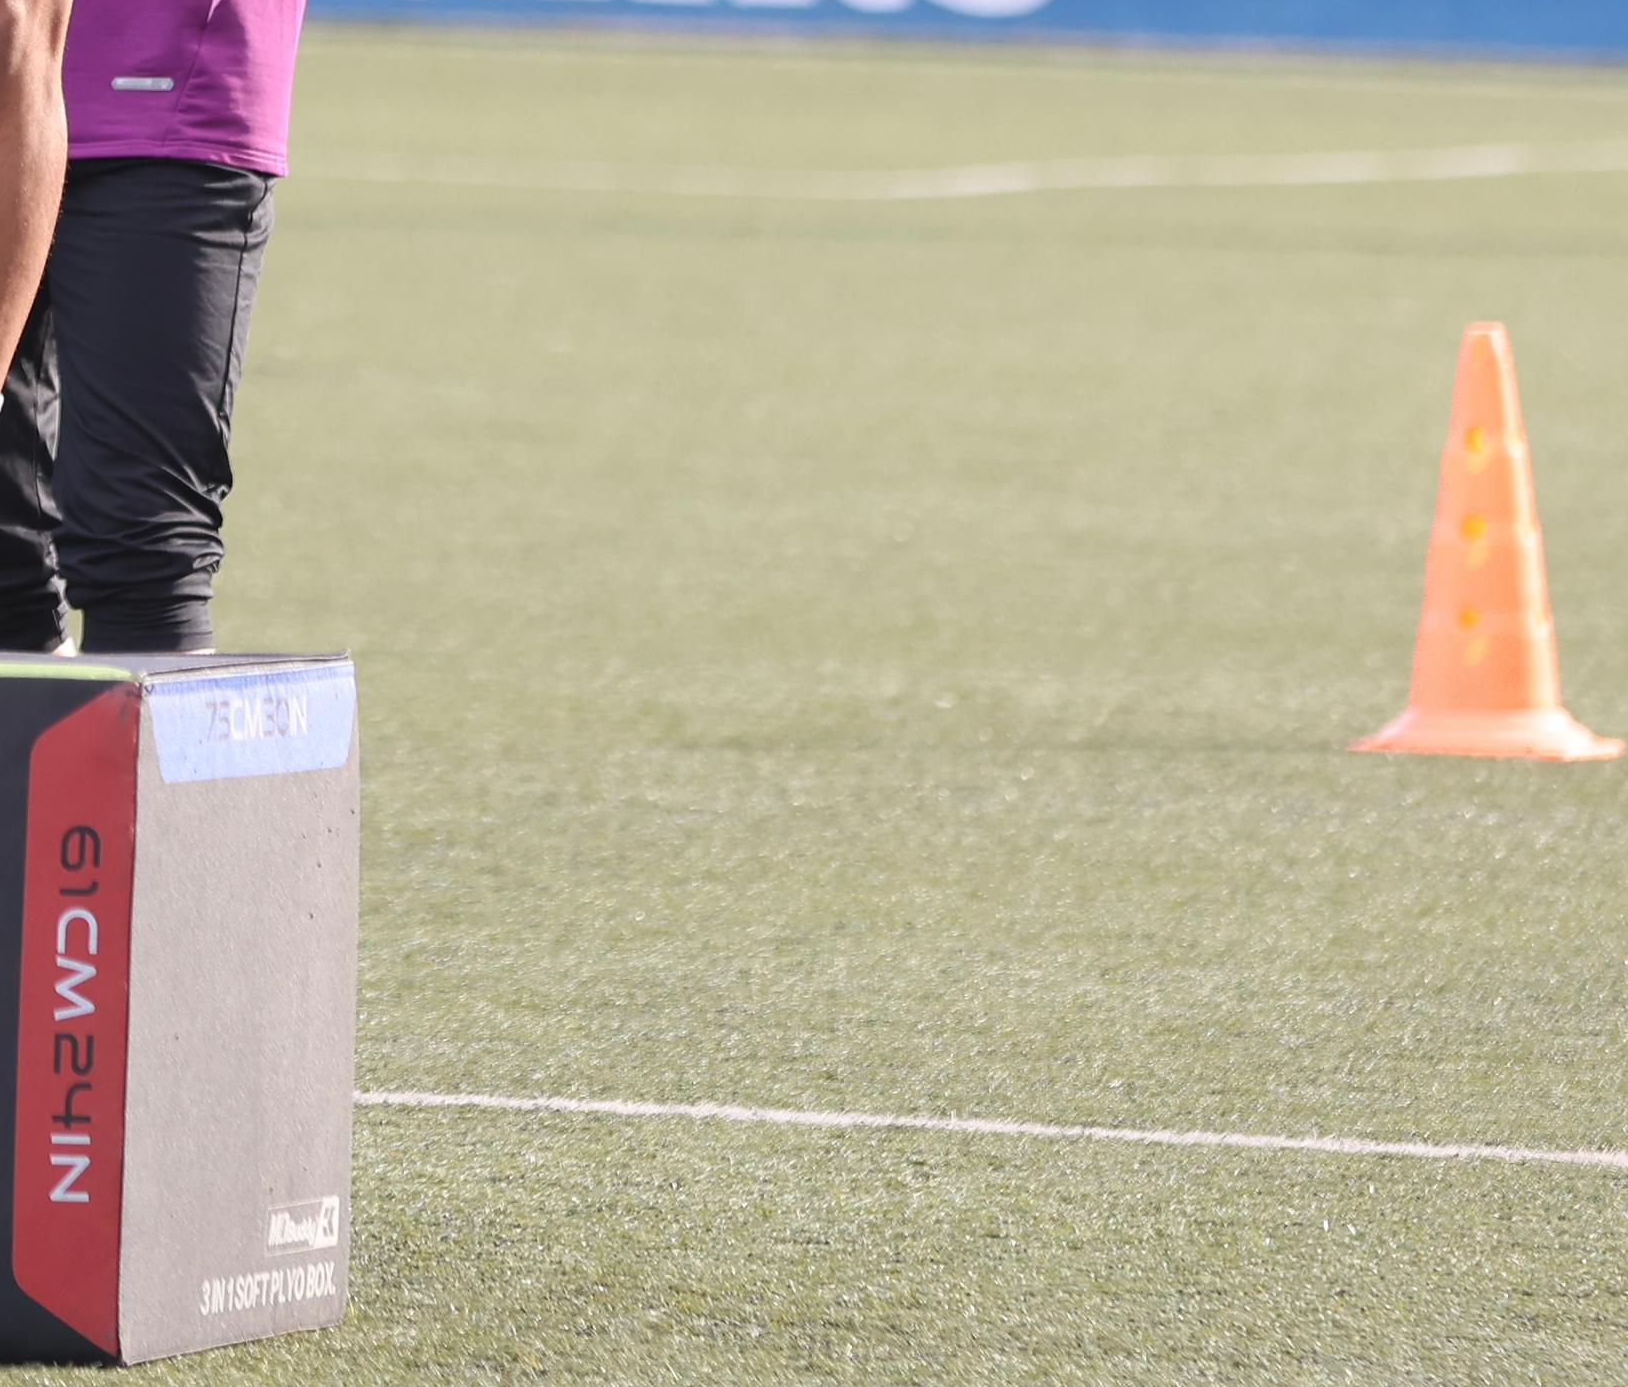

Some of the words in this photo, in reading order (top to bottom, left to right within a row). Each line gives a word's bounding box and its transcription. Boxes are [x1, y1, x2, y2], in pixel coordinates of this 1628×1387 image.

[200, 1279, 211, 1316] 3
[210, 1277, 226, 1314] IN
[226, 1277, 235, 1312] 1
[234, 1271, 270, 1311] SOFT
[270, 1265, 305, 1306] PLYO
[306, 1260, 337, 1300] BOX.
